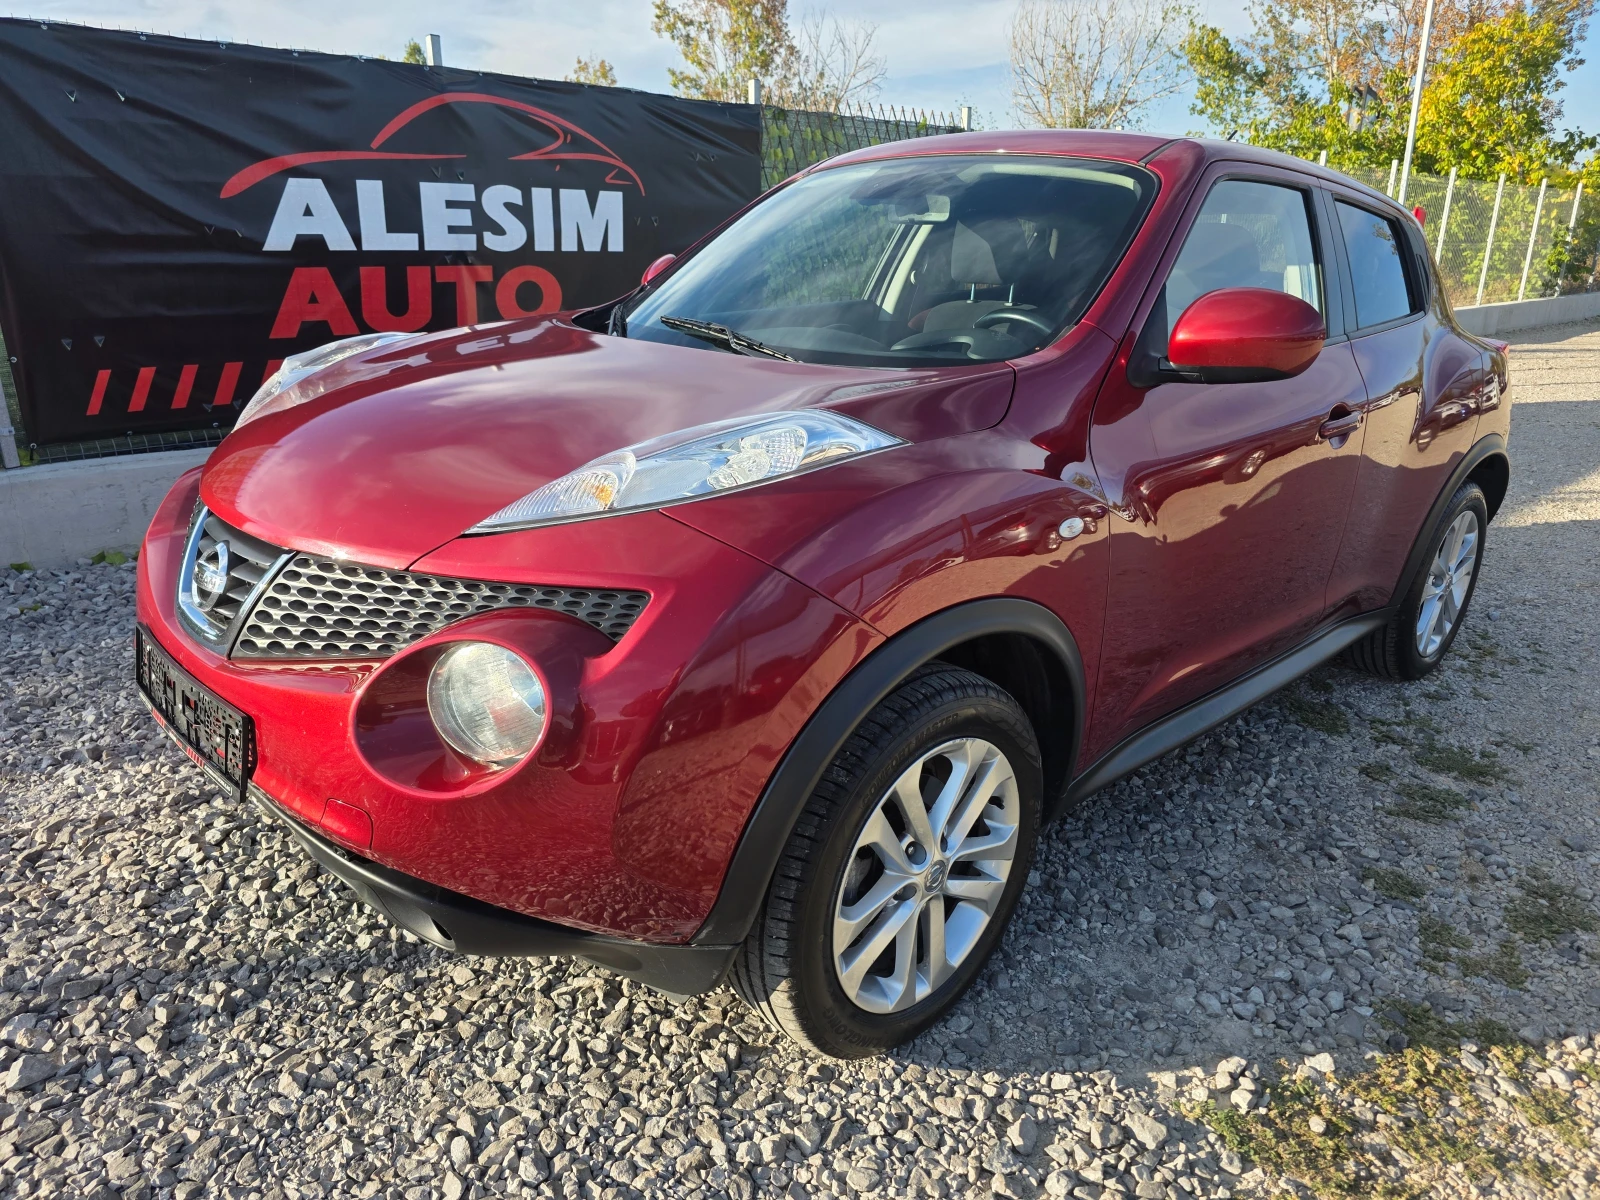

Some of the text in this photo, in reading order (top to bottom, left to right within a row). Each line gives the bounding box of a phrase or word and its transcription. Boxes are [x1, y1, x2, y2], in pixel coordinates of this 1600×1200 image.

[262, 177, 624, 253] ALESIM
[269, 265, 563, 339] AUTO
[914, 713, 959, 747] MASTER
